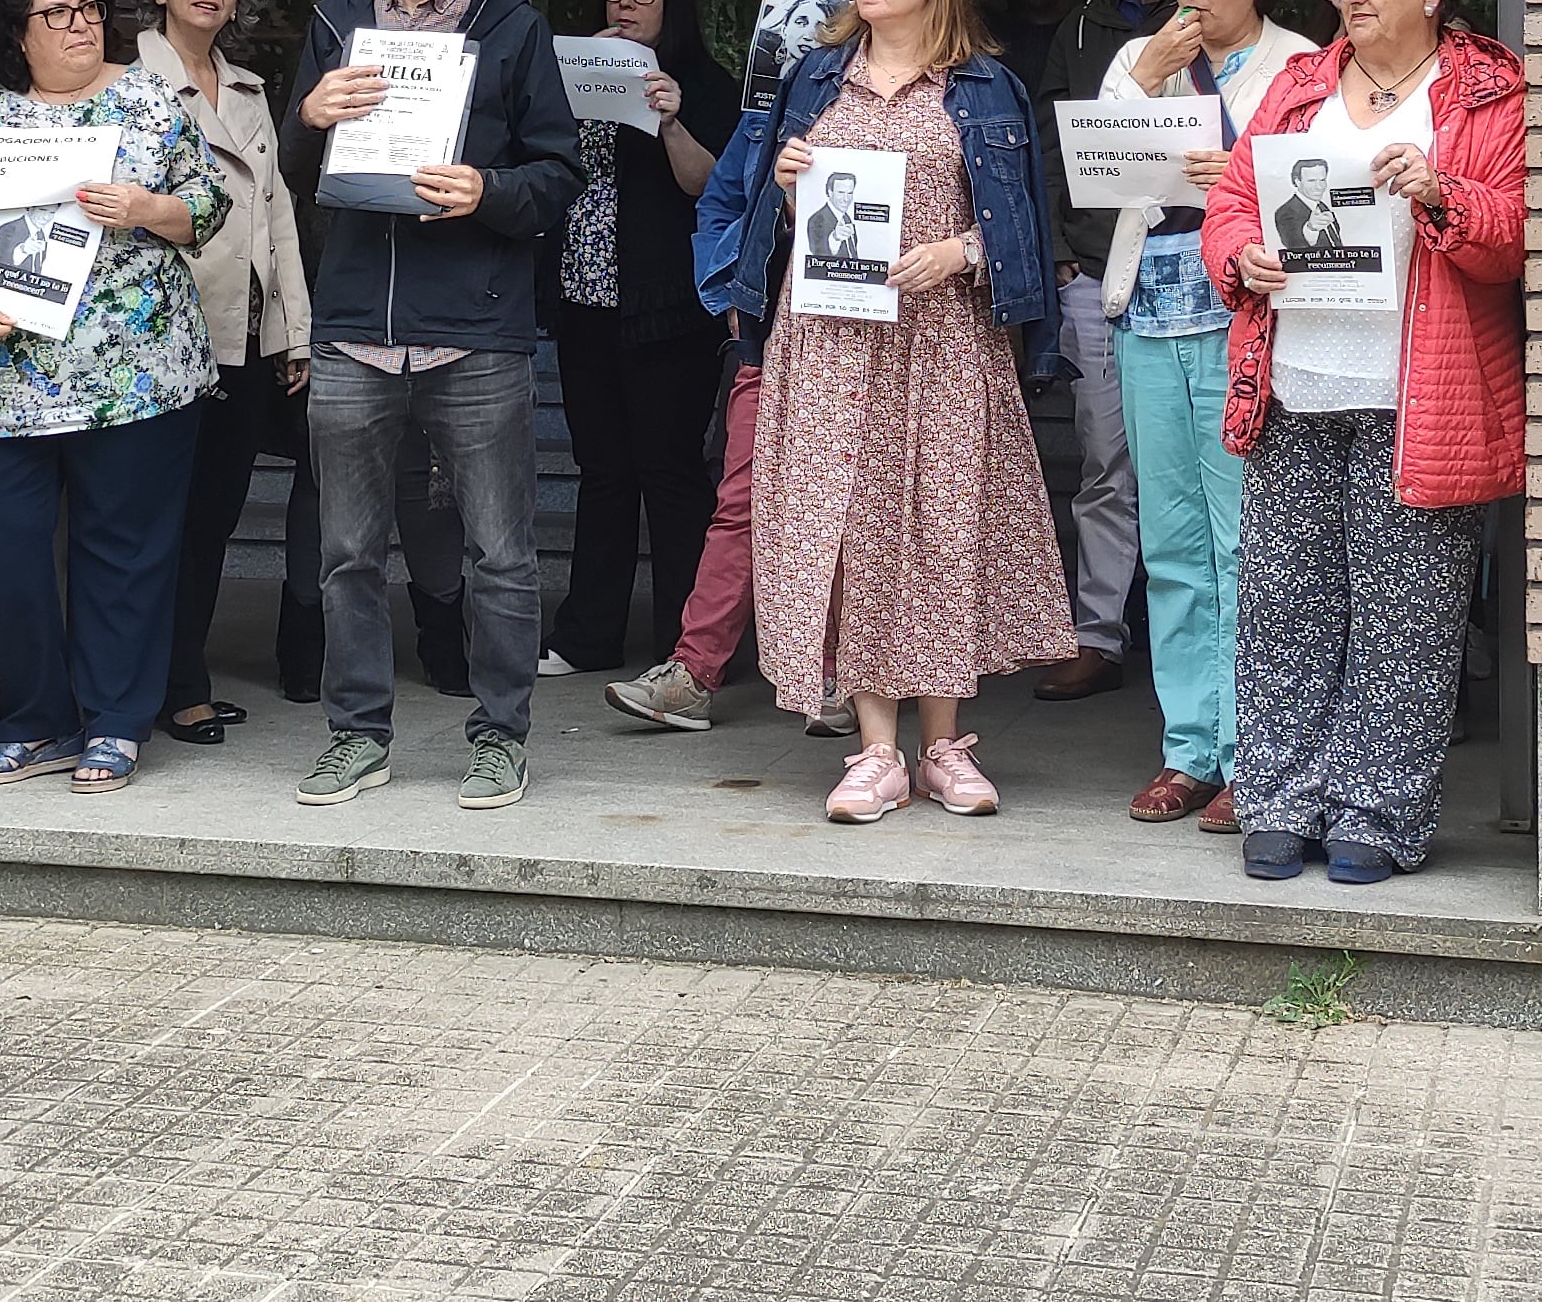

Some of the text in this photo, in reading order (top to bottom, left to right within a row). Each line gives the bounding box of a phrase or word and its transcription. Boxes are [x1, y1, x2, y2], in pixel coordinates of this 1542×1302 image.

[367, 64, 433, 82] UELGA
[574, 83, 627, 94] YO PARO
[1071, 116, 1203, 129] DEROGACION L.O.E.O.
[1076, 150, 1168, 162] RETRIBUCIONES
[1079, 166, 1121, 177] JUSTAS
[1281, 251, 1303, 263] ¿Por
[1304, 250, 1321, 261] qué
[1323, 250, 1331, 258] A
[1333, 250, 1344, 258] TI
[1371, 249, 1379, 258] lo
[826, 260, 840, 269] qué
[841, 260, 848, 269] A
[849, 261, 859, 270] TI
[871, 263, 878, 272] te
[879, 263, 887, 272] lo
[4, 269, 20, 280] qué
[19, 273, 28, 282] A
[29, 274, 40, 285] TI
[51, 282, 60, 291] te
[60, 283, 69, 294] lo
